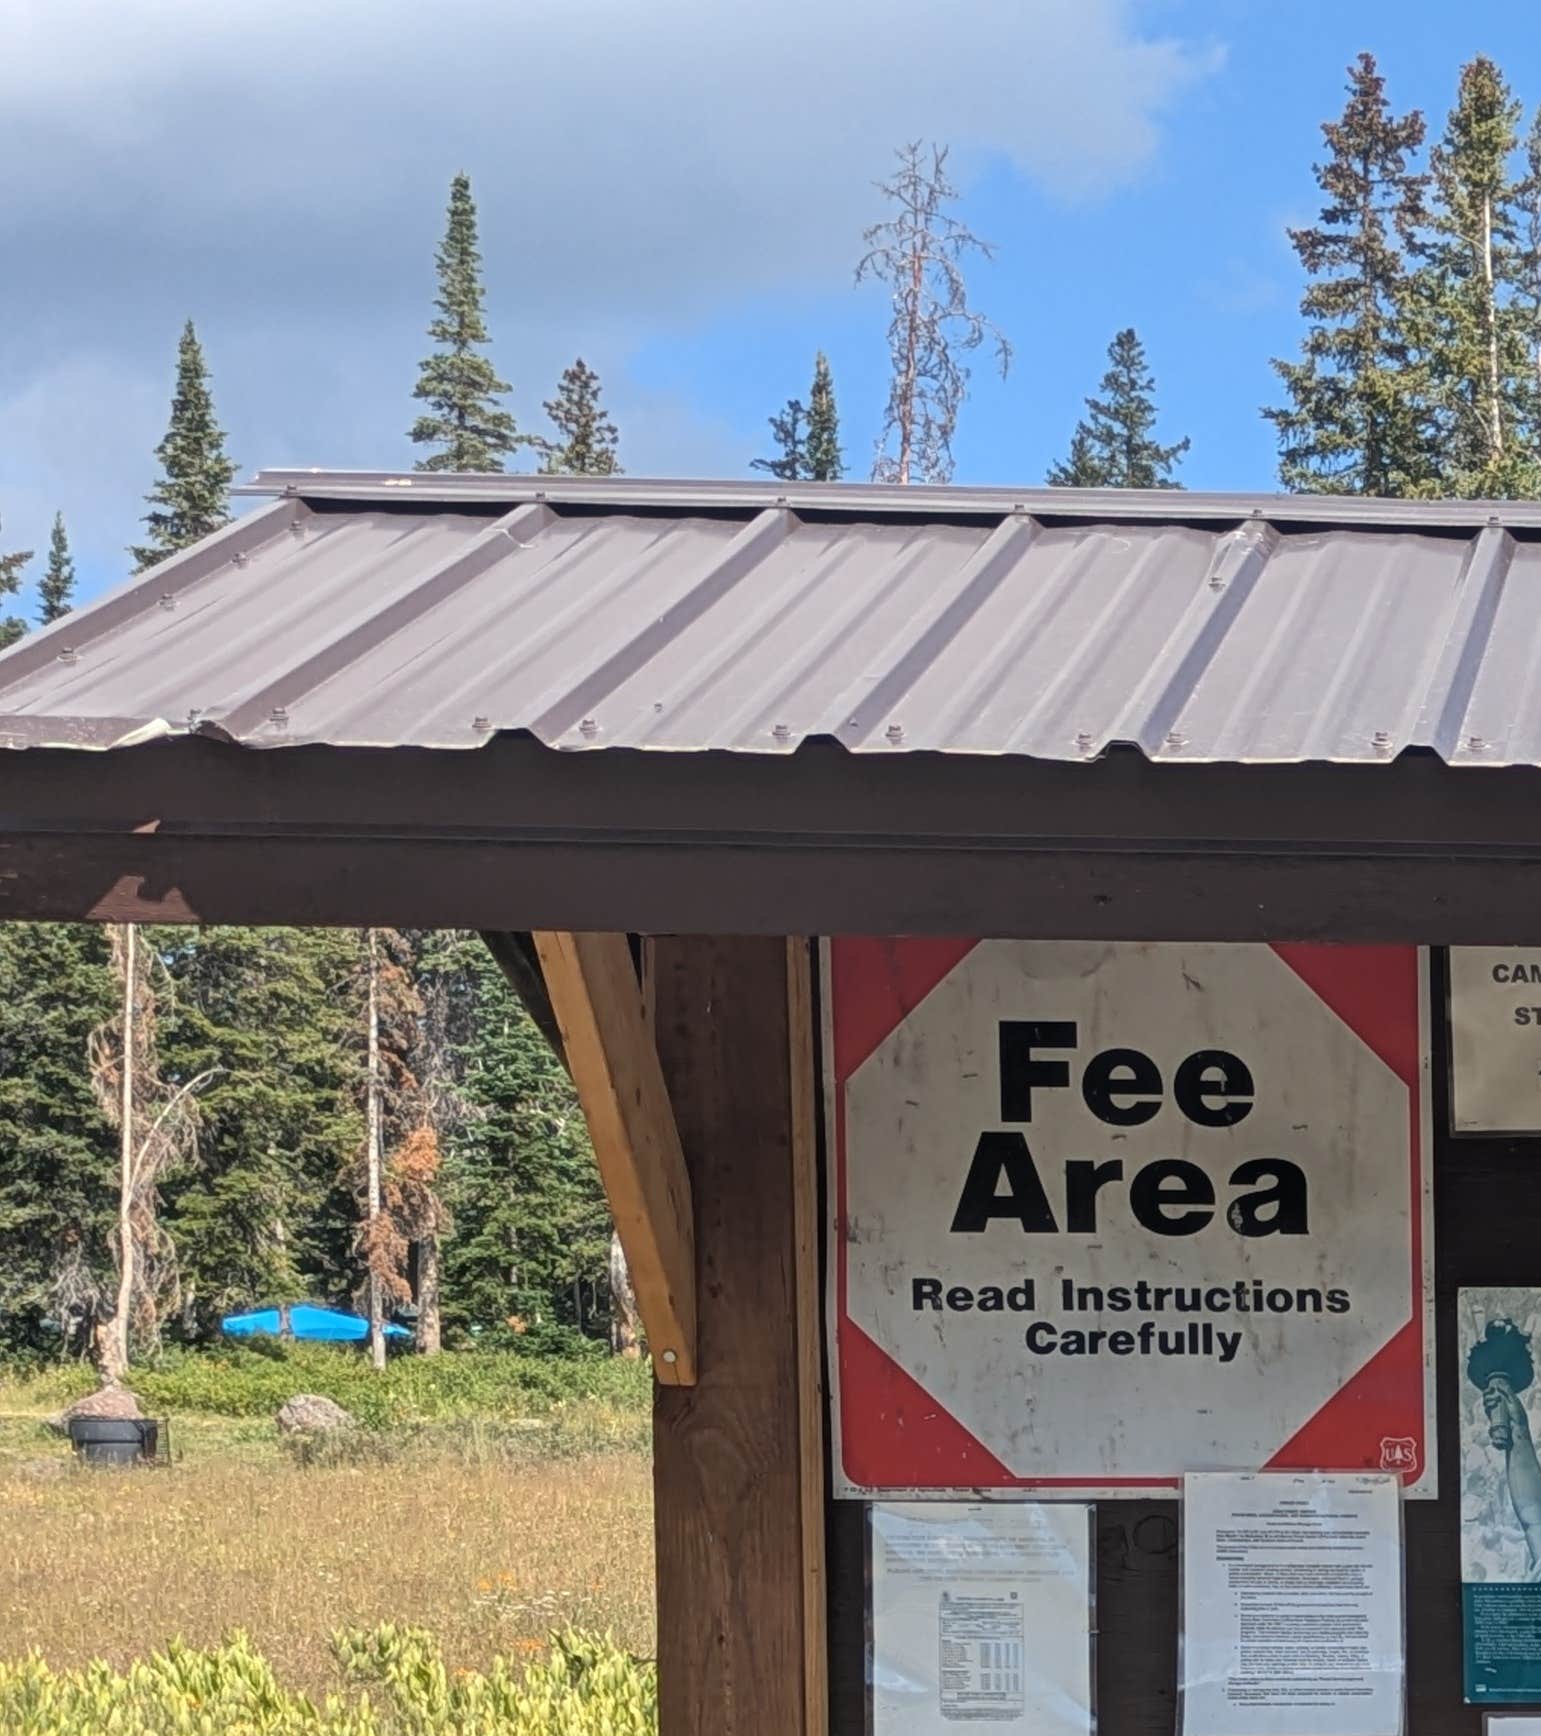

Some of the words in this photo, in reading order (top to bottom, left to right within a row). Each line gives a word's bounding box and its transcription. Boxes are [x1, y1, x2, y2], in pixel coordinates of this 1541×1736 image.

[998, 1020, 1255, 1127] Fee
[950, 1130, 1310, 1238] Area
[912, 1278, 1036, 1313] Read
[1061, 1278, 1351, 1315] Instructions
[1024, 1320, 1243, 1363] Carefully
